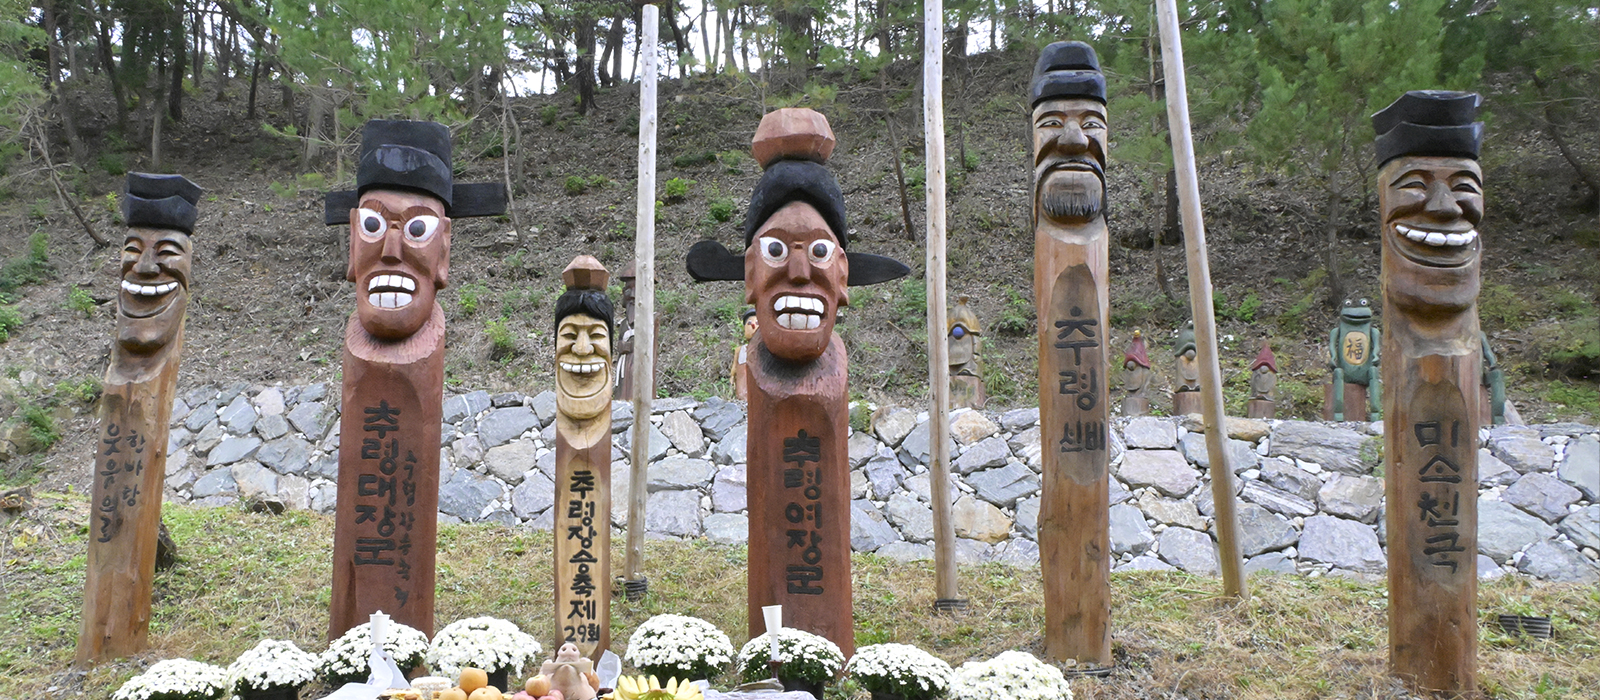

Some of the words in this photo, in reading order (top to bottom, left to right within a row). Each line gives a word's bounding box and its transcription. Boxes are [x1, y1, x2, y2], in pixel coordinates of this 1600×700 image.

[1054, 306, 1099, 411] 추령
[1346, 338, 1364, 360] 福
[125, 429, 146, 507] 한바탕
[353, 400, 401, 567] 추령대장군
[783, 428, 824, 596] 추령여장군
[564, 622, 600, 643] 29회
